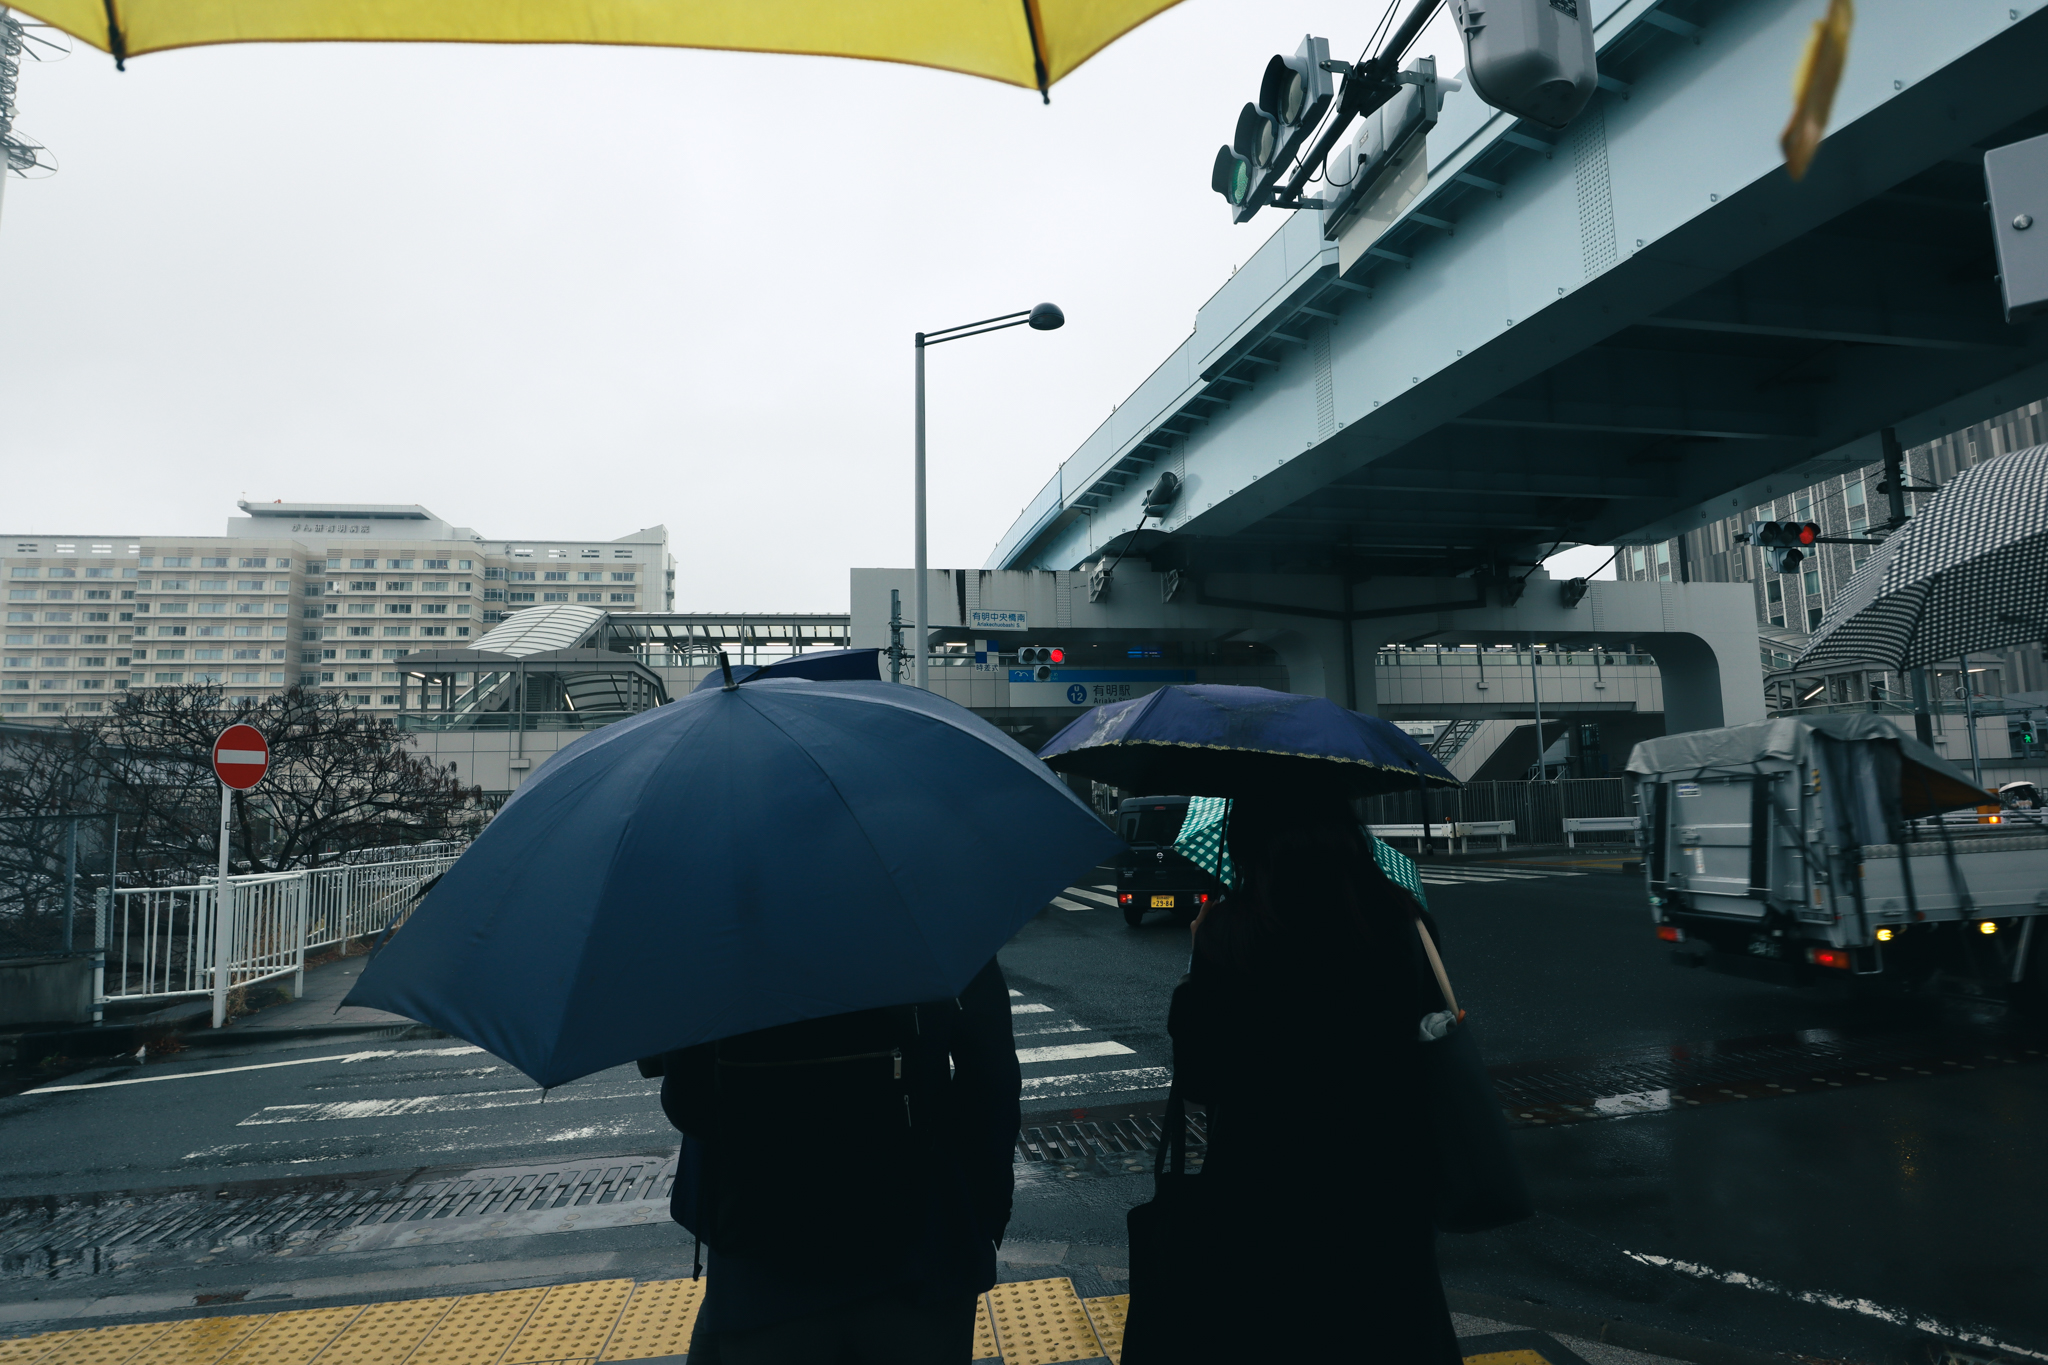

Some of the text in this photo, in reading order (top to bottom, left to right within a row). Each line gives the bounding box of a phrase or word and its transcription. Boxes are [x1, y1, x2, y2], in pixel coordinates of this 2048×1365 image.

[972, 611, 1025, 622] 有明中央橋南
[976, 664, 999, 672] 時差式
[1093, 684, 1131, 696] 有明駅
[1071, 692, 1083, 702] 12
